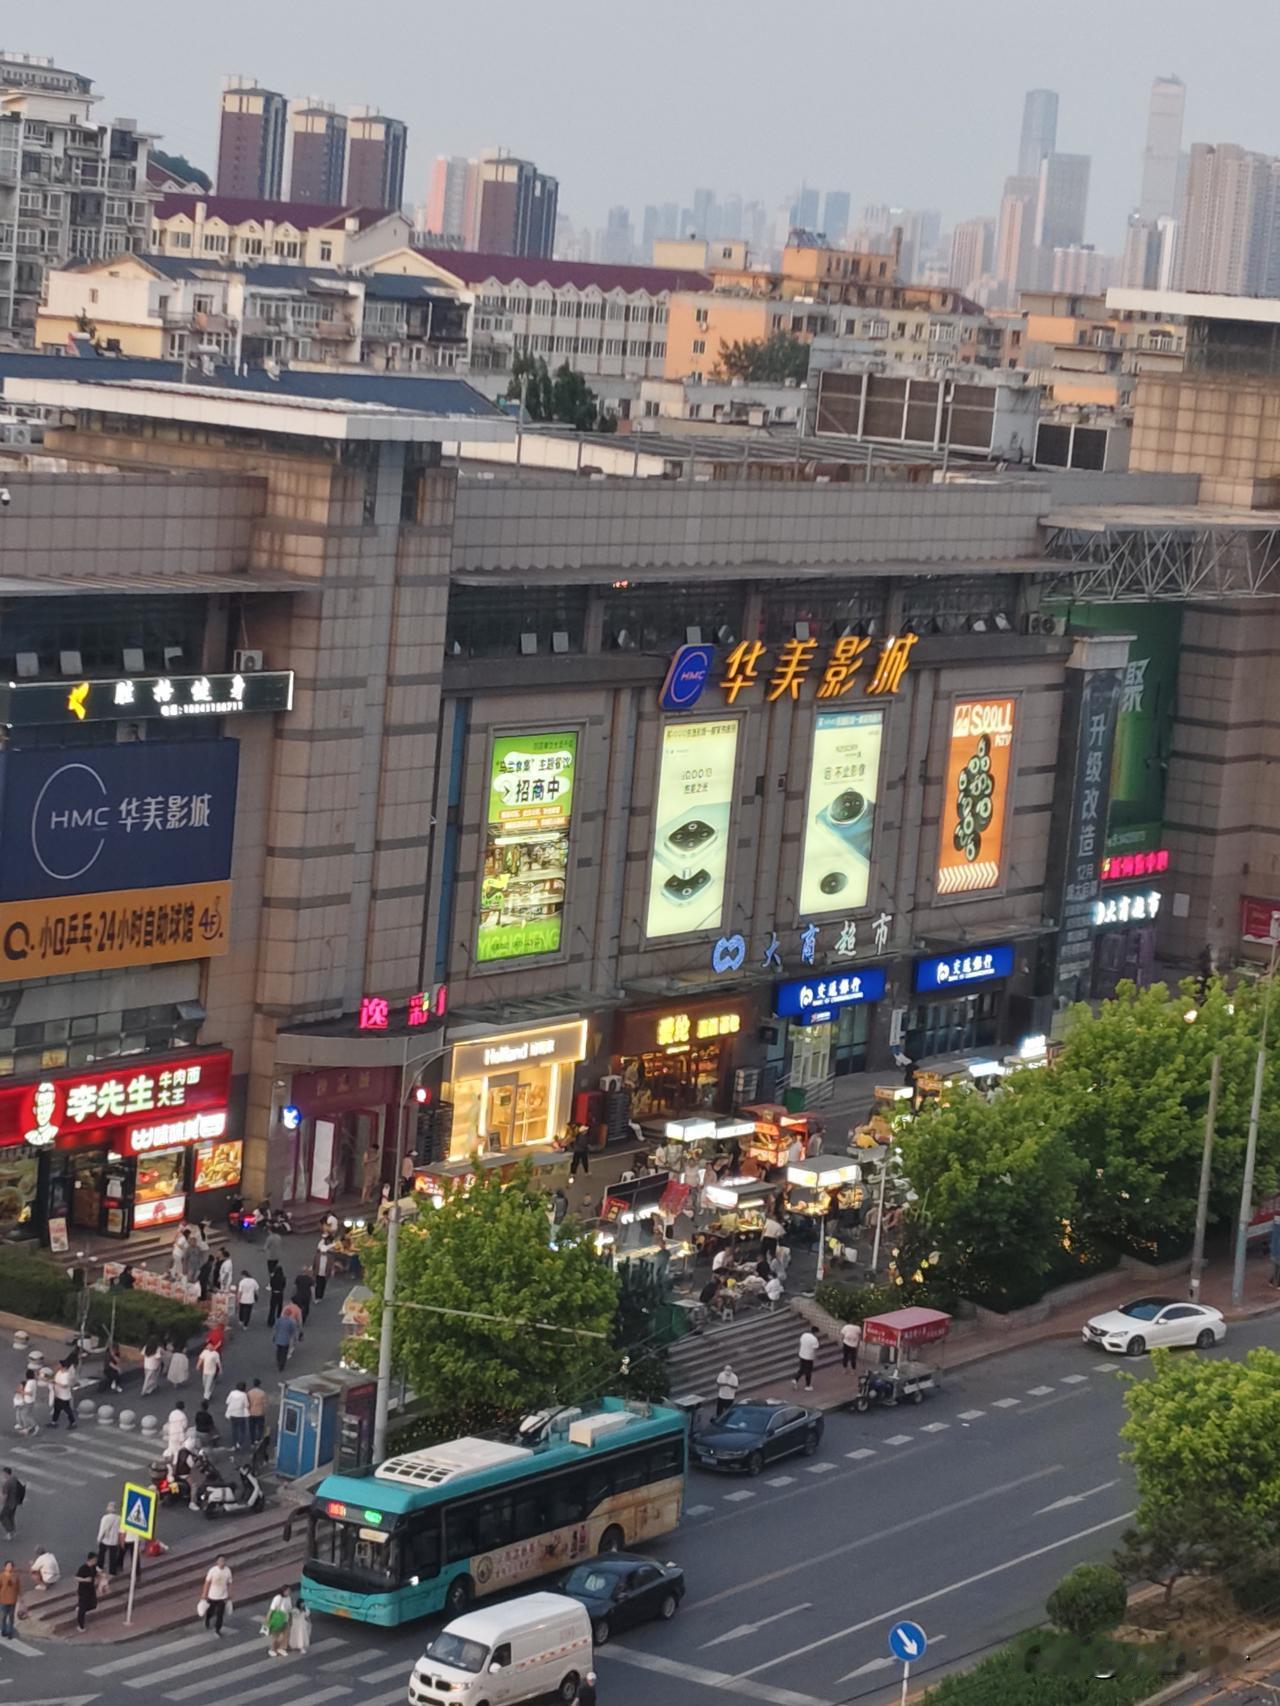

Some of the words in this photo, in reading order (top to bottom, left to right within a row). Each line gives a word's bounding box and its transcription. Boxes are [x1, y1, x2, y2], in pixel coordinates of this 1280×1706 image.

[680, 669, 705, 682] HMC
[720, 633, 918, 704] 华美影城
[1121, 657, 1151, 712] 聚
[515, 776, 560, 804] 招商中
[1077, 713, 1107, 857] 升级改造
[50, 806, 110, 830] HMC
[117, 794, 212, 833] 华美影城
[763, 912, 892, 967] 大商超市
[952, 954, 993, 975] 交通银行
[816, 976, 861, 999] 交通银行
[66, 1074, 155, 1123] 李先生
[158, 1066, 201, 1088] 牛肉面
[157, 1088, 185, 1107] 大王
